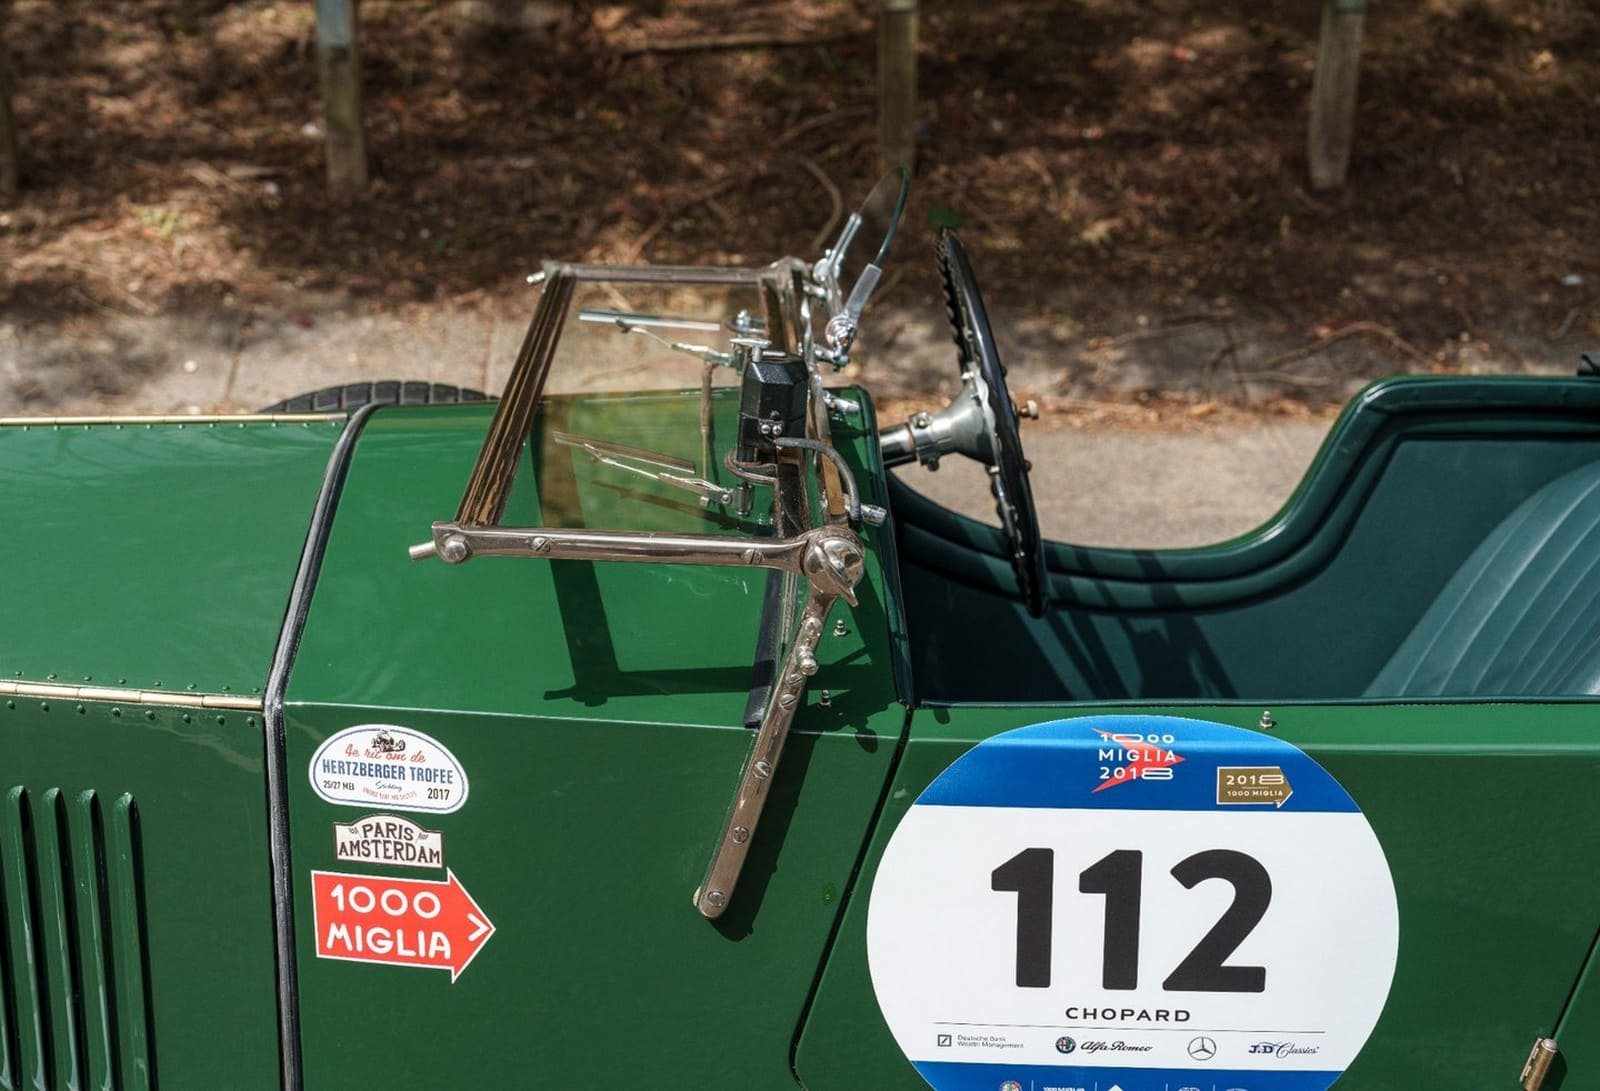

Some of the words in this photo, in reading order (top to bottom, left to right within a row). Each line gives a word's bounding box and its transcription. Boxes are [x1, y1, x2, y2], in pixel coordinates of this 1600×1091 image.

[1100, 733, 1175, 744] 1000
[410, 750, 426, 763] de
[1099, 749, 1177, 762] MIGLIA
[322, 759, 406, 781] HERTZBERGER
[409, 766, 453, 785] TROFEE
[1099, 766, 1174, 780] 2018
[323, 780, 341, 790] 25/27
[1226, 774, 1284, 785] 2018
[427, 788, 450, 801] 2017
[1252, 789, 1284, 797] MIGLIA
[362, 822, 414, 841] PARIS
[339, 839, 440, 864] AMSTERDAM
[331, 884, 441, 919] 1000
[991, 848, 1273, 993] 112
[326, 922, 451, 960] MIGLIA
[1065, 1007, 1191, 1022] CHOPARD
[1080, 1040, 1109, 1054] Alfa
[1110, 1040, 1153, 1052] Romeo
